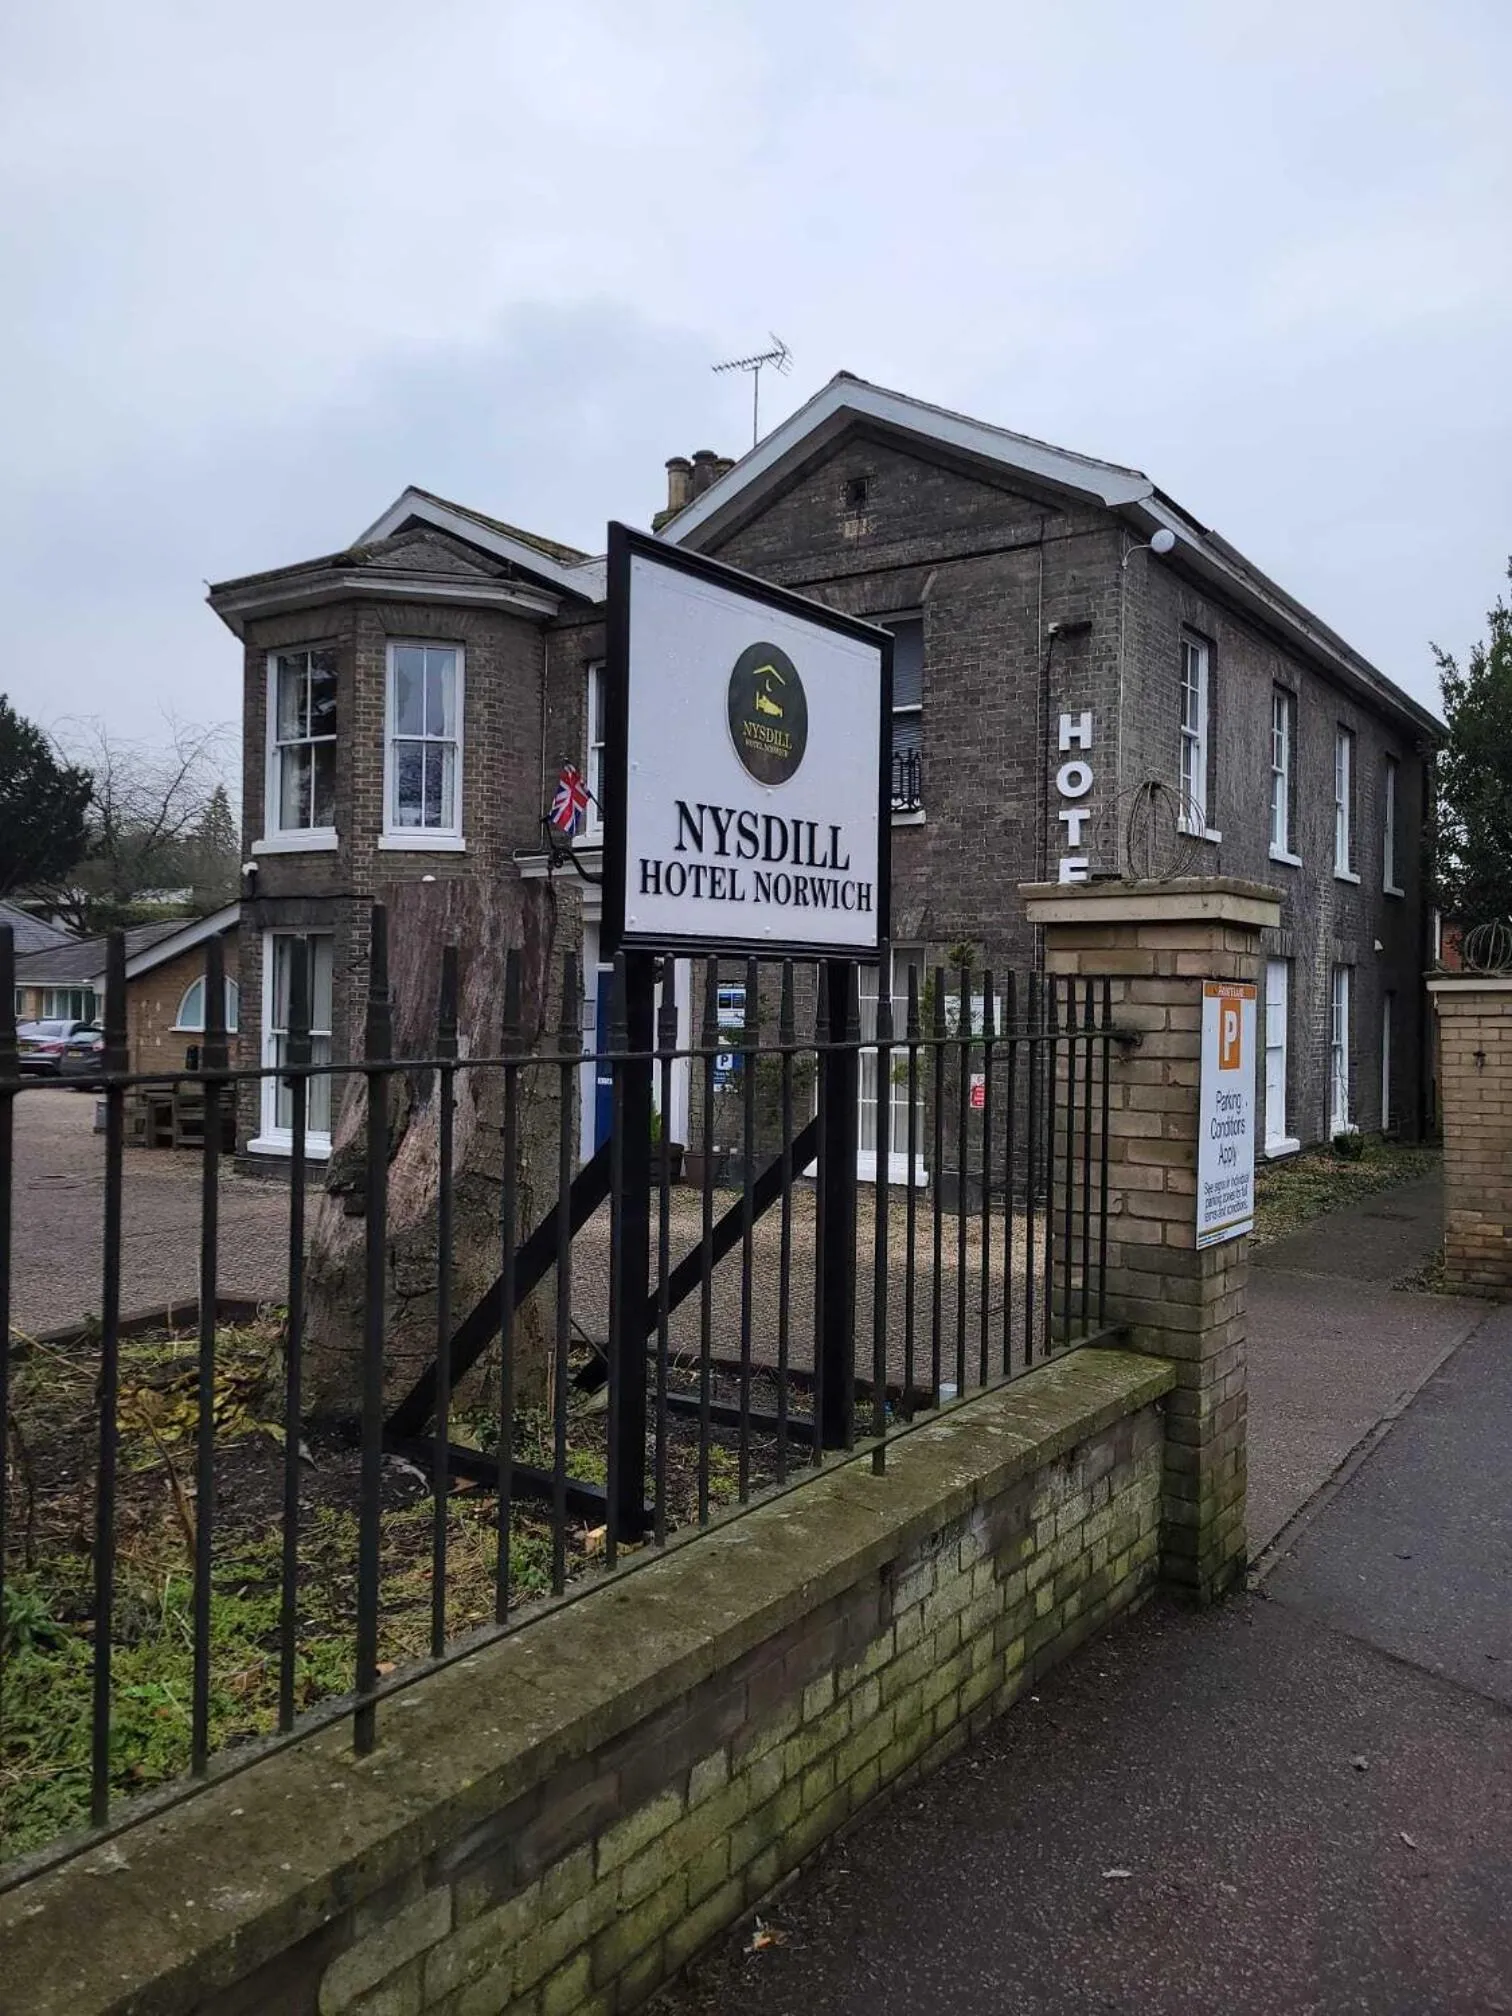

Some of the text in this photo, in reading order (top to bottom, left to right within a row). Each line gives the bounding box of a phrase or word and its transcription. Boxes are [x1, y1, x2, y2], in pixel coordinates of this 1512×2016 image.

[743, 720, 793, 750] NYSDILL
[674, 800, 850, 871] NYSDILL
[639, 858, 873, 912] HOTEL NORWICH
[1223, 1009, 1238, 1062] P
[1216, 1090, 1241, 1114] Parking
[1211, 1116, 1245, 1139] Conditions
[1218, 1142, 1236, 1167] Apply
